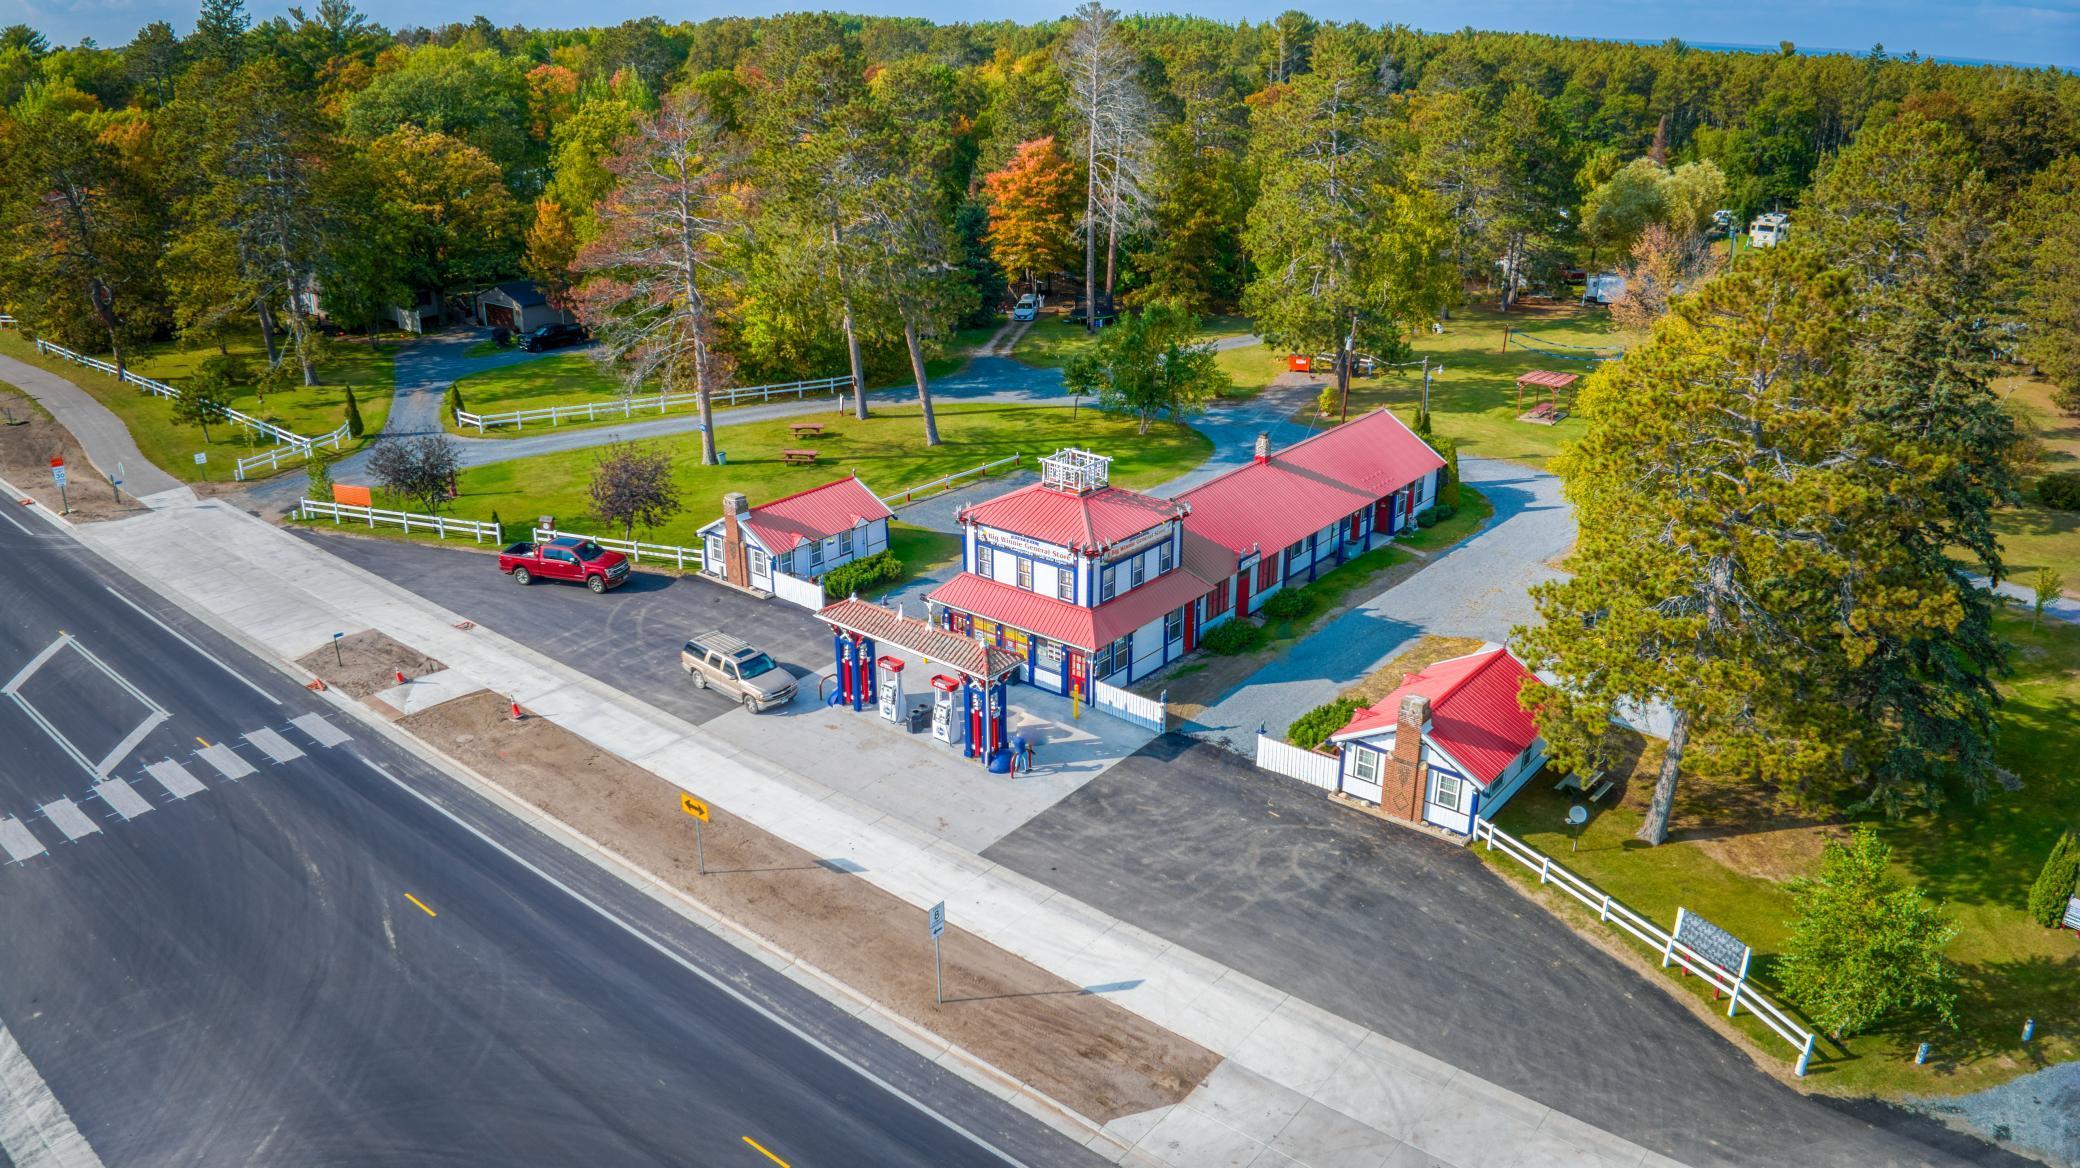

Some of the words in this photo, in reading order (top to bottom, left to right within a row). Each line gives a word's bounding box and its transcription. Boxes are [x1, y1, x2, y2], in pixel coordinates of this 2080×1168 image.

[988, 532, 999, 542] Big
[1000, 535, 1023, 547] Winnie
[1024, 543, 1051, 556] General
[1052, 550, 1071, 561] Store
